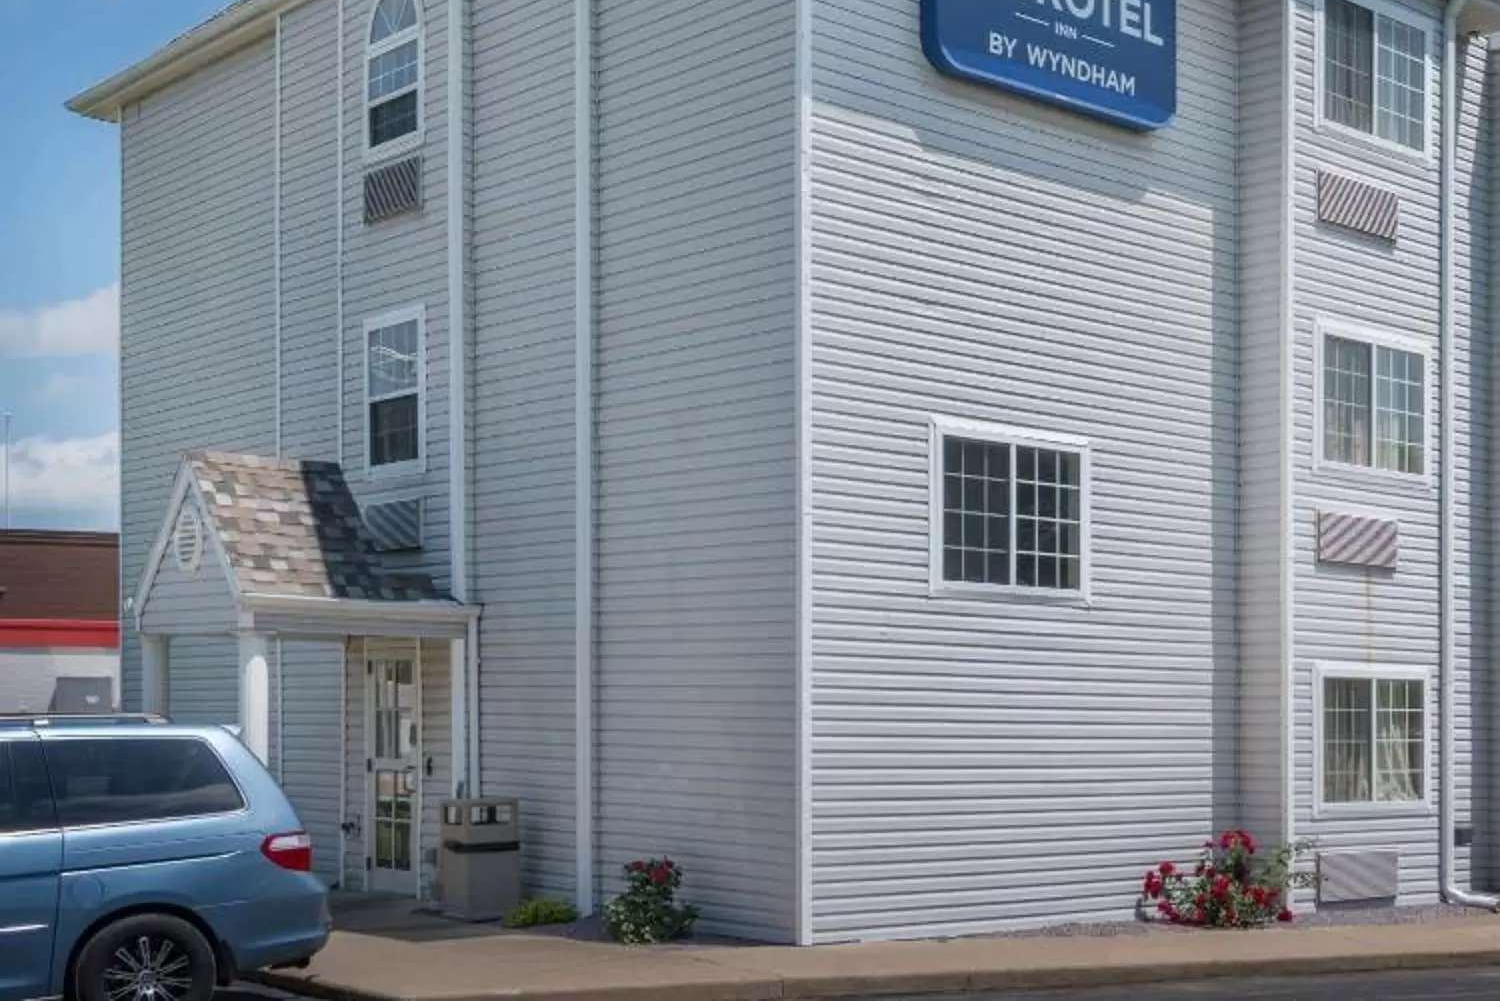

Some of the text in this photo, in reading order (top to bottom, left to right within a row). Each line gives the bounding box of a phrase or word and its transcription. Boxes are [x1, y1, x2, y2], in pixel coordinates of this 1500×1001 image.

[1055, 22, 1077, 40] INN
[988, 31, 1136, 96] BY WYNDHAM
